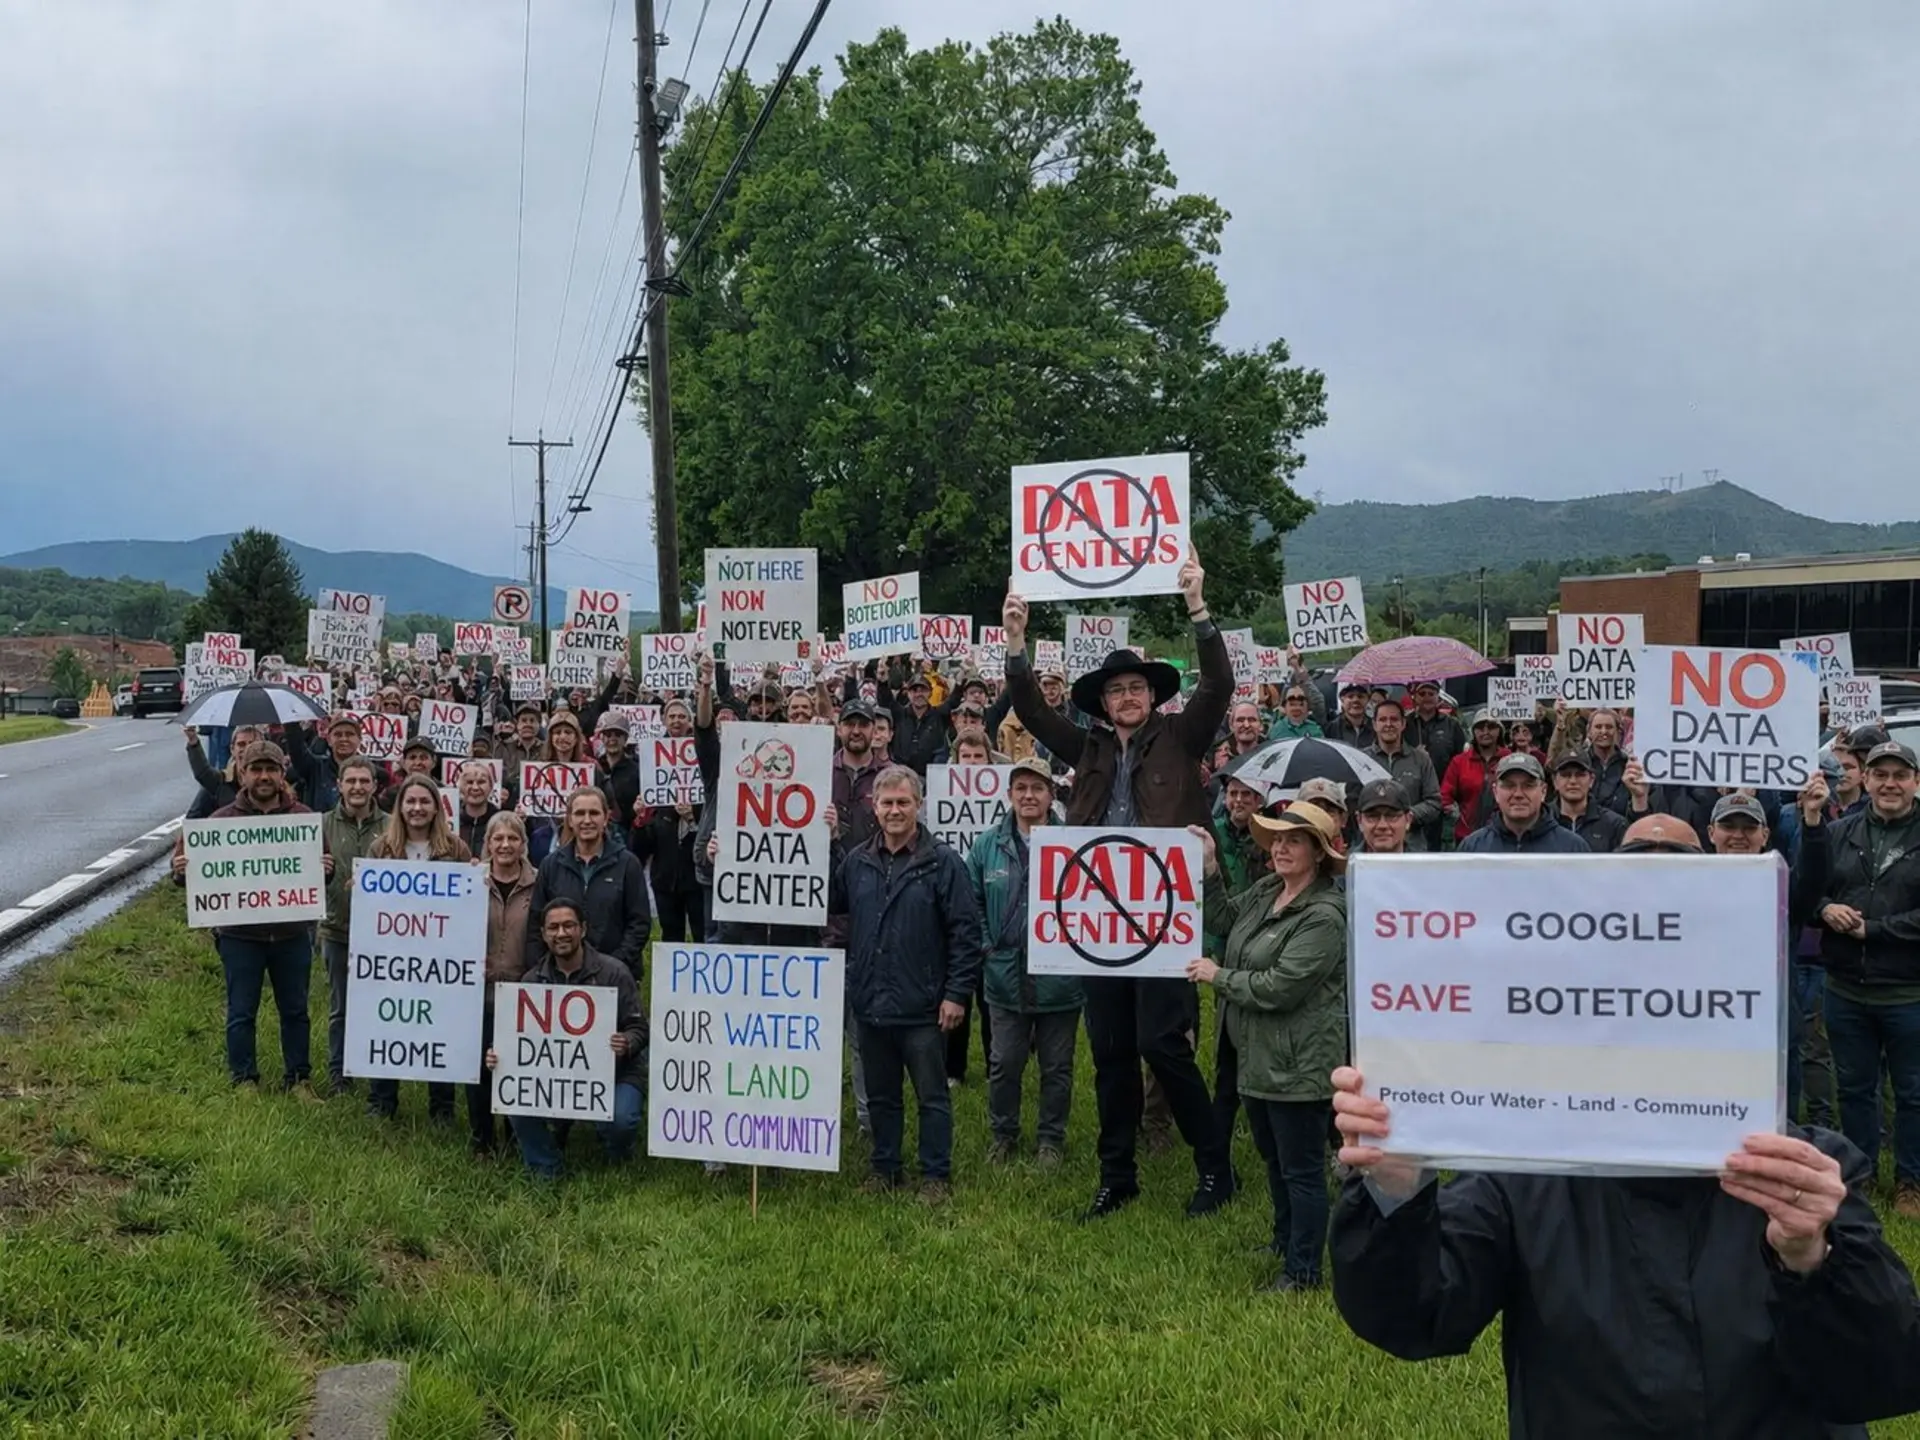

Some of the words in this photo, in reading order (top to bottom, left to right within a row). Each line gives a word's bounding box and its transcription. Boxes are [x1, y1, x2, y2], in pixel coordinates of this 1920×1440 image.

[1022, 475, 1180, 535] DATA
[1019, 533, 1180, 573] CENTERS
[718, 561, 755, 581] NOT
[757, 560, 804, 581] HERE
[579, 588, 619, 613] NO
[721, 590, 765, 612] NOW
[864, 577, 899, 603] NO
[1302, 580, 1344, 605] NO
[574, 613, 620, 632] DATA
[847, 597, 918, 626] BOTETOURT
[1296, 603, 1357, 627] DATA
[721, 621, 756, 641] NOT
[759, 621, 803, 641] EVER
[847, 622, 918, 651] BEAUTIFUL
[1080, 617, 1113, 636] NO
[1292, 624, 1365, 650] CENTER
[1578, 616, 1625, 645] NO
[565, 631, 624, 651] CENTER
[654, 635, 685, 653] NO
[1795, 637, 1834, 655] NO
[648, 654, 691, 670] DATA
[1569, 648, 1635, 673] DATA
[1820, 656, 1843, 670] TA
[644, 672, 696, 689] CENTER
[1562, 678, 1636, 701] CENTER
[1670, 650, 1786, 710] NO
[432, 703, 466, 725] NO
[429, 719, 465, 738] DATA
[1671, 710, 1779, 747] DATA
[434, 739, 469, 755] NTER
[655, 739, 700, 767] NO
[525, 765, 589, 790] DATA
[656, 768, 704, 786] DATA
[1643, 748, 1809, 787] CENTERS
[949, 767, 1000, 797] NO
[736, 782, 816, 829] NO
[937, 800, 1008, 825] DATA
[188, 830, 221, 847] OUR
[227, 825, 319, 846] COMMUNITY
[735, 831, 810, 865] DATA
[202, 860, 237, 878] OUR
[242, 857, 303, 877] FUTURE
[1039, 845, 1196, 902] DATA
[195, 892, 231, 911] NOT
[238, 890, 272, 909] FOR
[277, 887, 318, 907] SALE
[717, 871, 825, 908] CENTER
[377, 911, 450, 938] DON'T
[1034, 911, 1195, 945] CENTERS
[1374, 910, 1477, 939] STOP
[1505, 911, 1682, 941] GOOGLE
[356, 955, 476, 986] DEGRADE
[672, 950, 830, 999] PROTECT
[378, 997, 433, 1025] OUR
[516, 988, 596, 1036] NO
[1370, 983, 1472, 1013] SAVE
[1507, 986, 1761, 1019] BOTETOURT
[664, 1009, 712, 1045] OUR
[724, 1011, 821, 1051] WATER
[369, 1039, 447, 1069] HOME
[517, 1037, 590, 1071] DATA
[662, 1058, 712, 1094] OUR
[727, 1062, 810, 1100] LAND
[498, 1075, 607, 1112] CENTER
[1380, 1087, 1445, 1105] Protect
[1450, 1090, 1485, 1106] Our
[1490, 1092, 1546, 1109] Water
[1567, 1095, 1615, 1111] Land
[1634, 1097, 1749, 1121] Community
[662, 1107, 714, 1145] OUR
[724, 1111, 836, 1156] COMMUNITY
